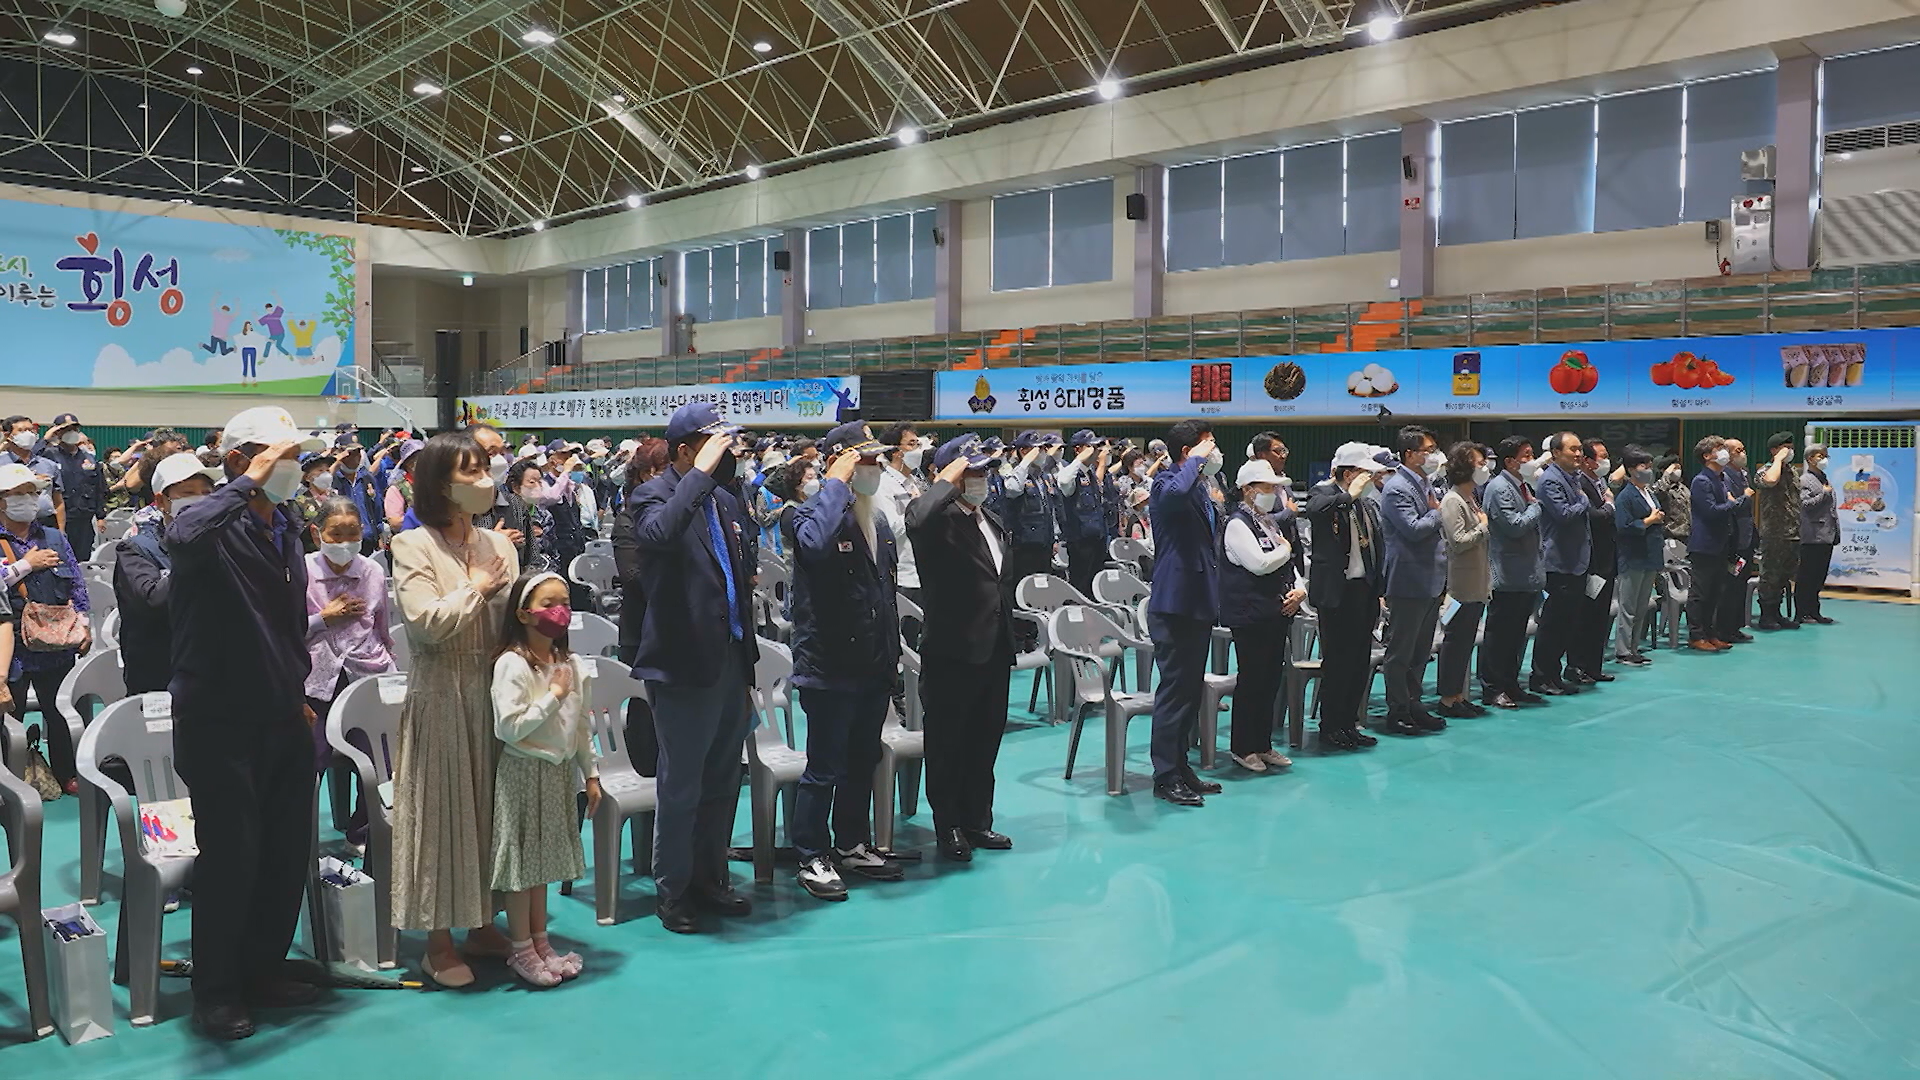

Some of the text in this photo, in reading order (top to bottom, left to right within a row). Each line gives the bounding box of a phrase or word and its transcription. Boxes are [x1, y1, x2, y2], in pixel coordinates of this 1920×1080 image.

[56, 233, 184, 327] 횡성
[511, 400, 538, 420] 최고의
[539, 398, 586, 418] 스포츠메카
[589, 397, 613, 418] 횡성을
[731, 388, 789, 415] 환영합니다!
[797, 401, 825, 416] 7330
[1017, 387, 1050, 412] 횡성
